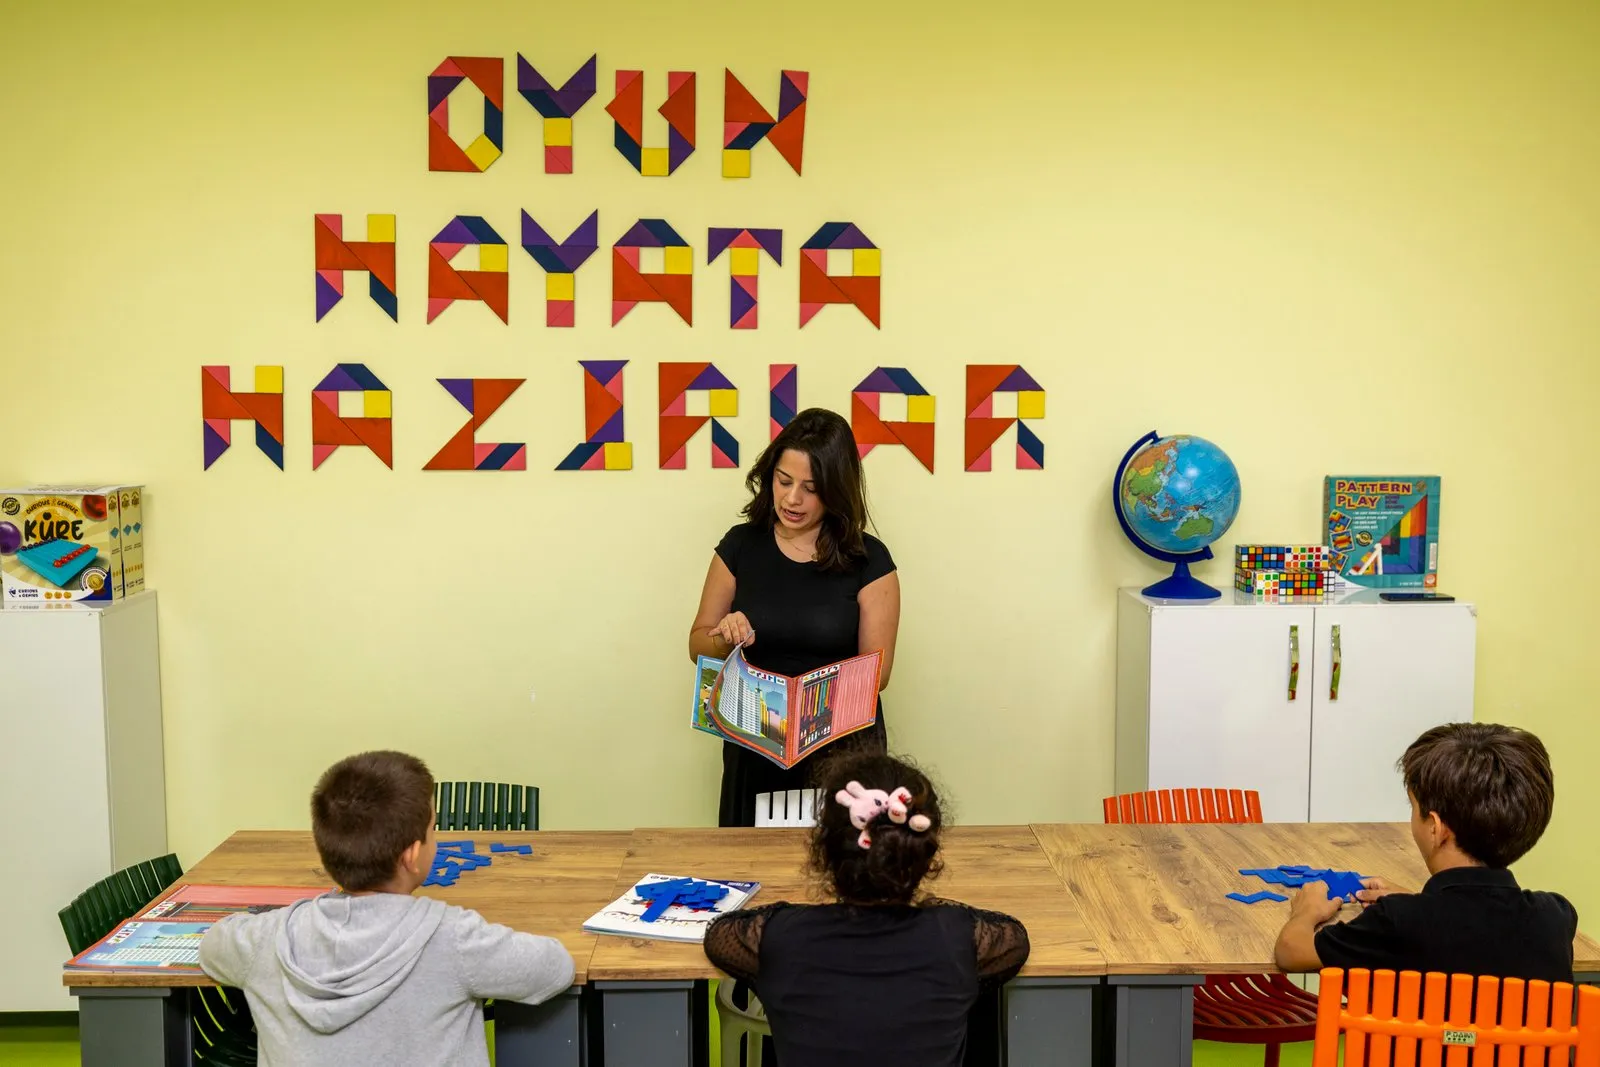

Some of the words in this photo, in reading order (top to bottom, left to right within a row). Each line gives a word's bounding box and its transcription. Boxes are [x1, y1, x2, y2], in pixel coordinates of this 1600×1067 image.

[427, 51, 809, 178] OYUN
[314, 207, 881, 330] HAYATA
[1336, 481, 1412, 494] PATTERN
[26, 499, 51, 514] CURIOUS
[56, 500, 79, 514] GENIUS
[1336, 494, 1379, 509] PLAY
